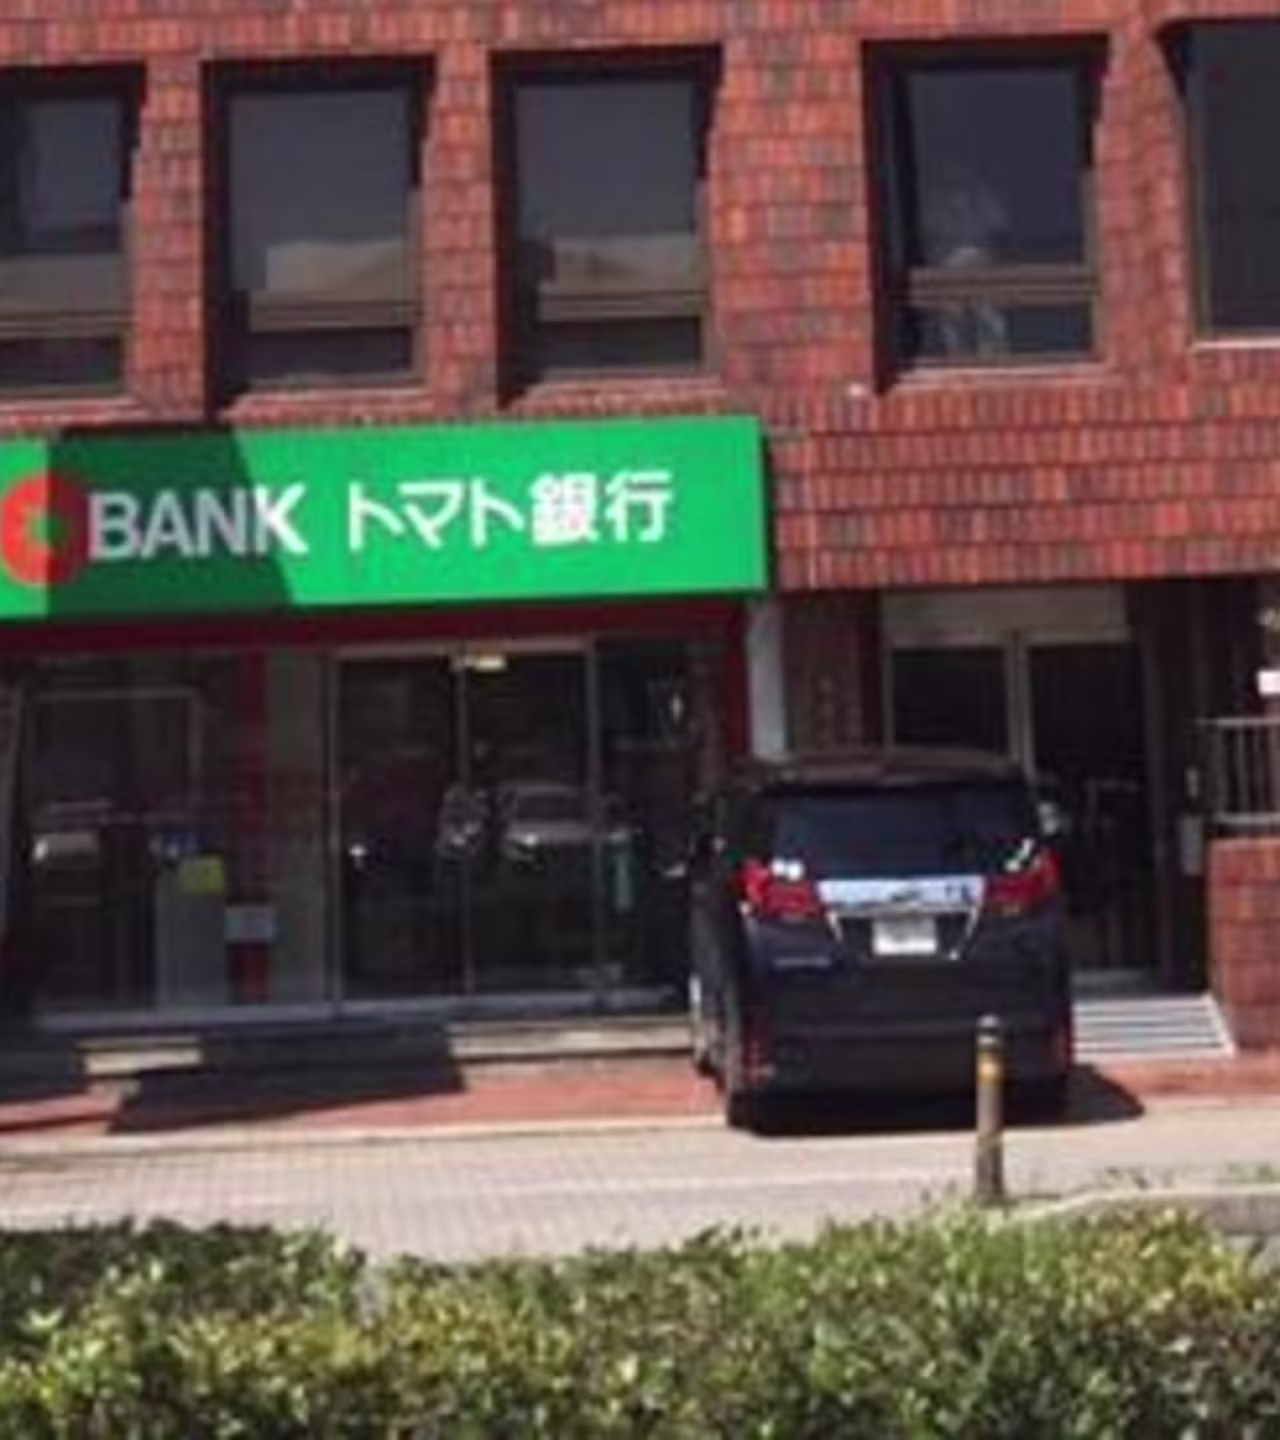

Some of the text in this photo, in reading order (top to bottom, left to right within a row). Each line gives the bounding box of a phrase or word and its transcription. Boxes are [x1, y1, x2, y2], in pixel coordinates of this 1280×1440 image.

[87, 469, 674, 559] BANK トマト銀行
